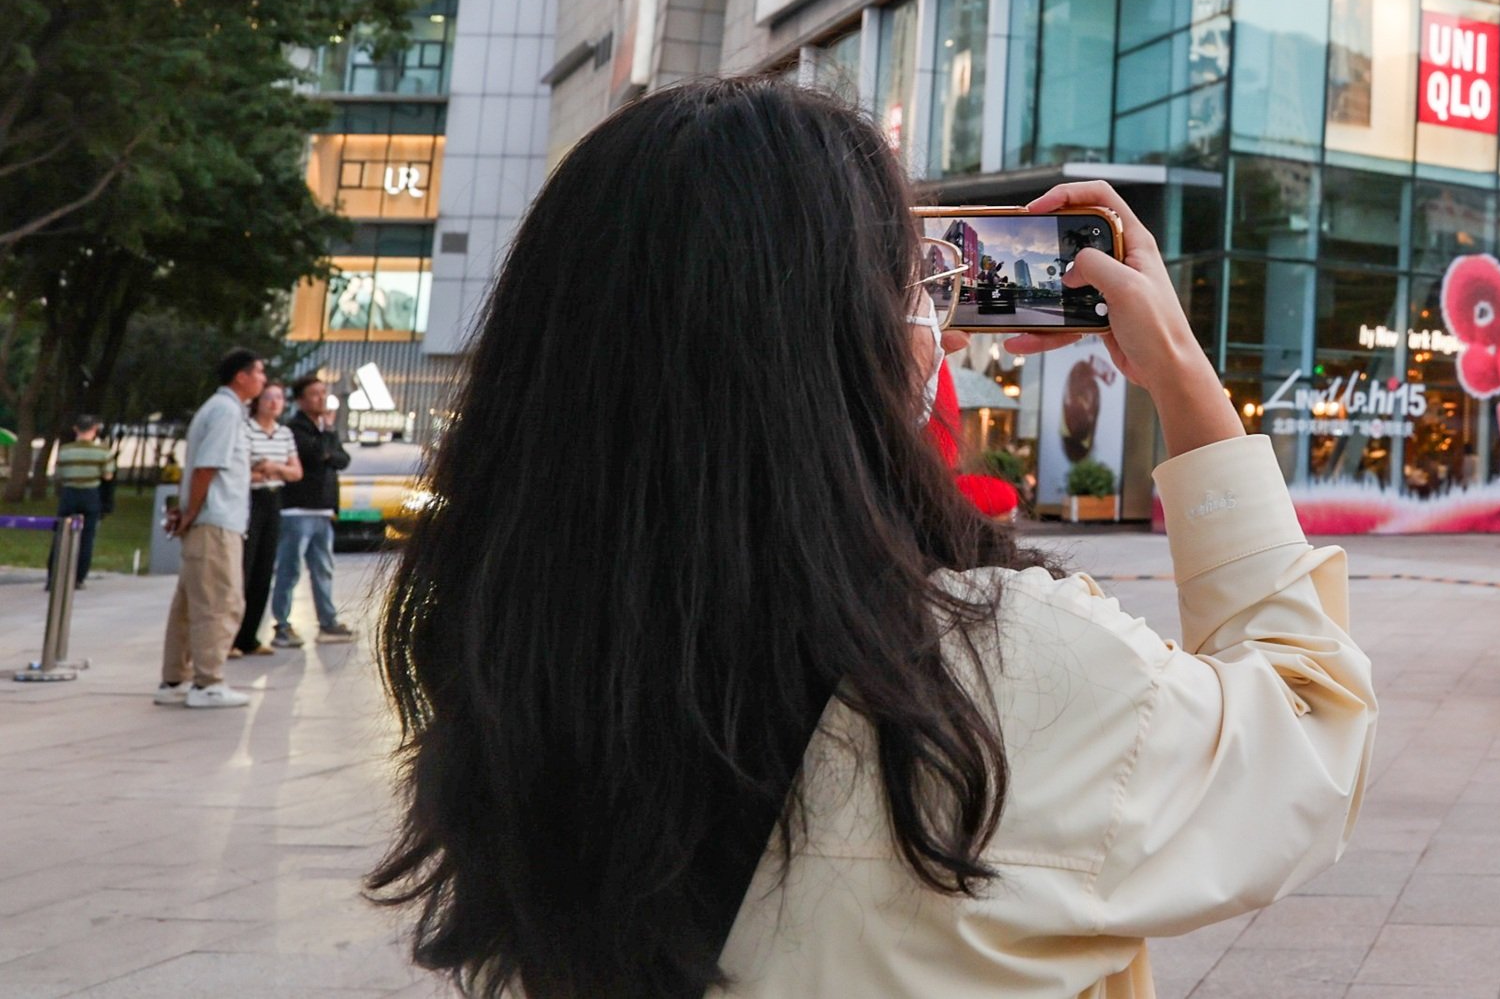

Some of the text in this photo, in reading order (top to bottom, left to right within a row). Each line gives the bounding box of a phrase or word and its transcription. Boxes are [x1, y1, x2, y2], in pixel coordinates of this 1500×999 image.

[1429, 23, 1488, 75] UNI
[1426, 70, 1492, 122] QLO
[384, 166, 425, 199] UR
